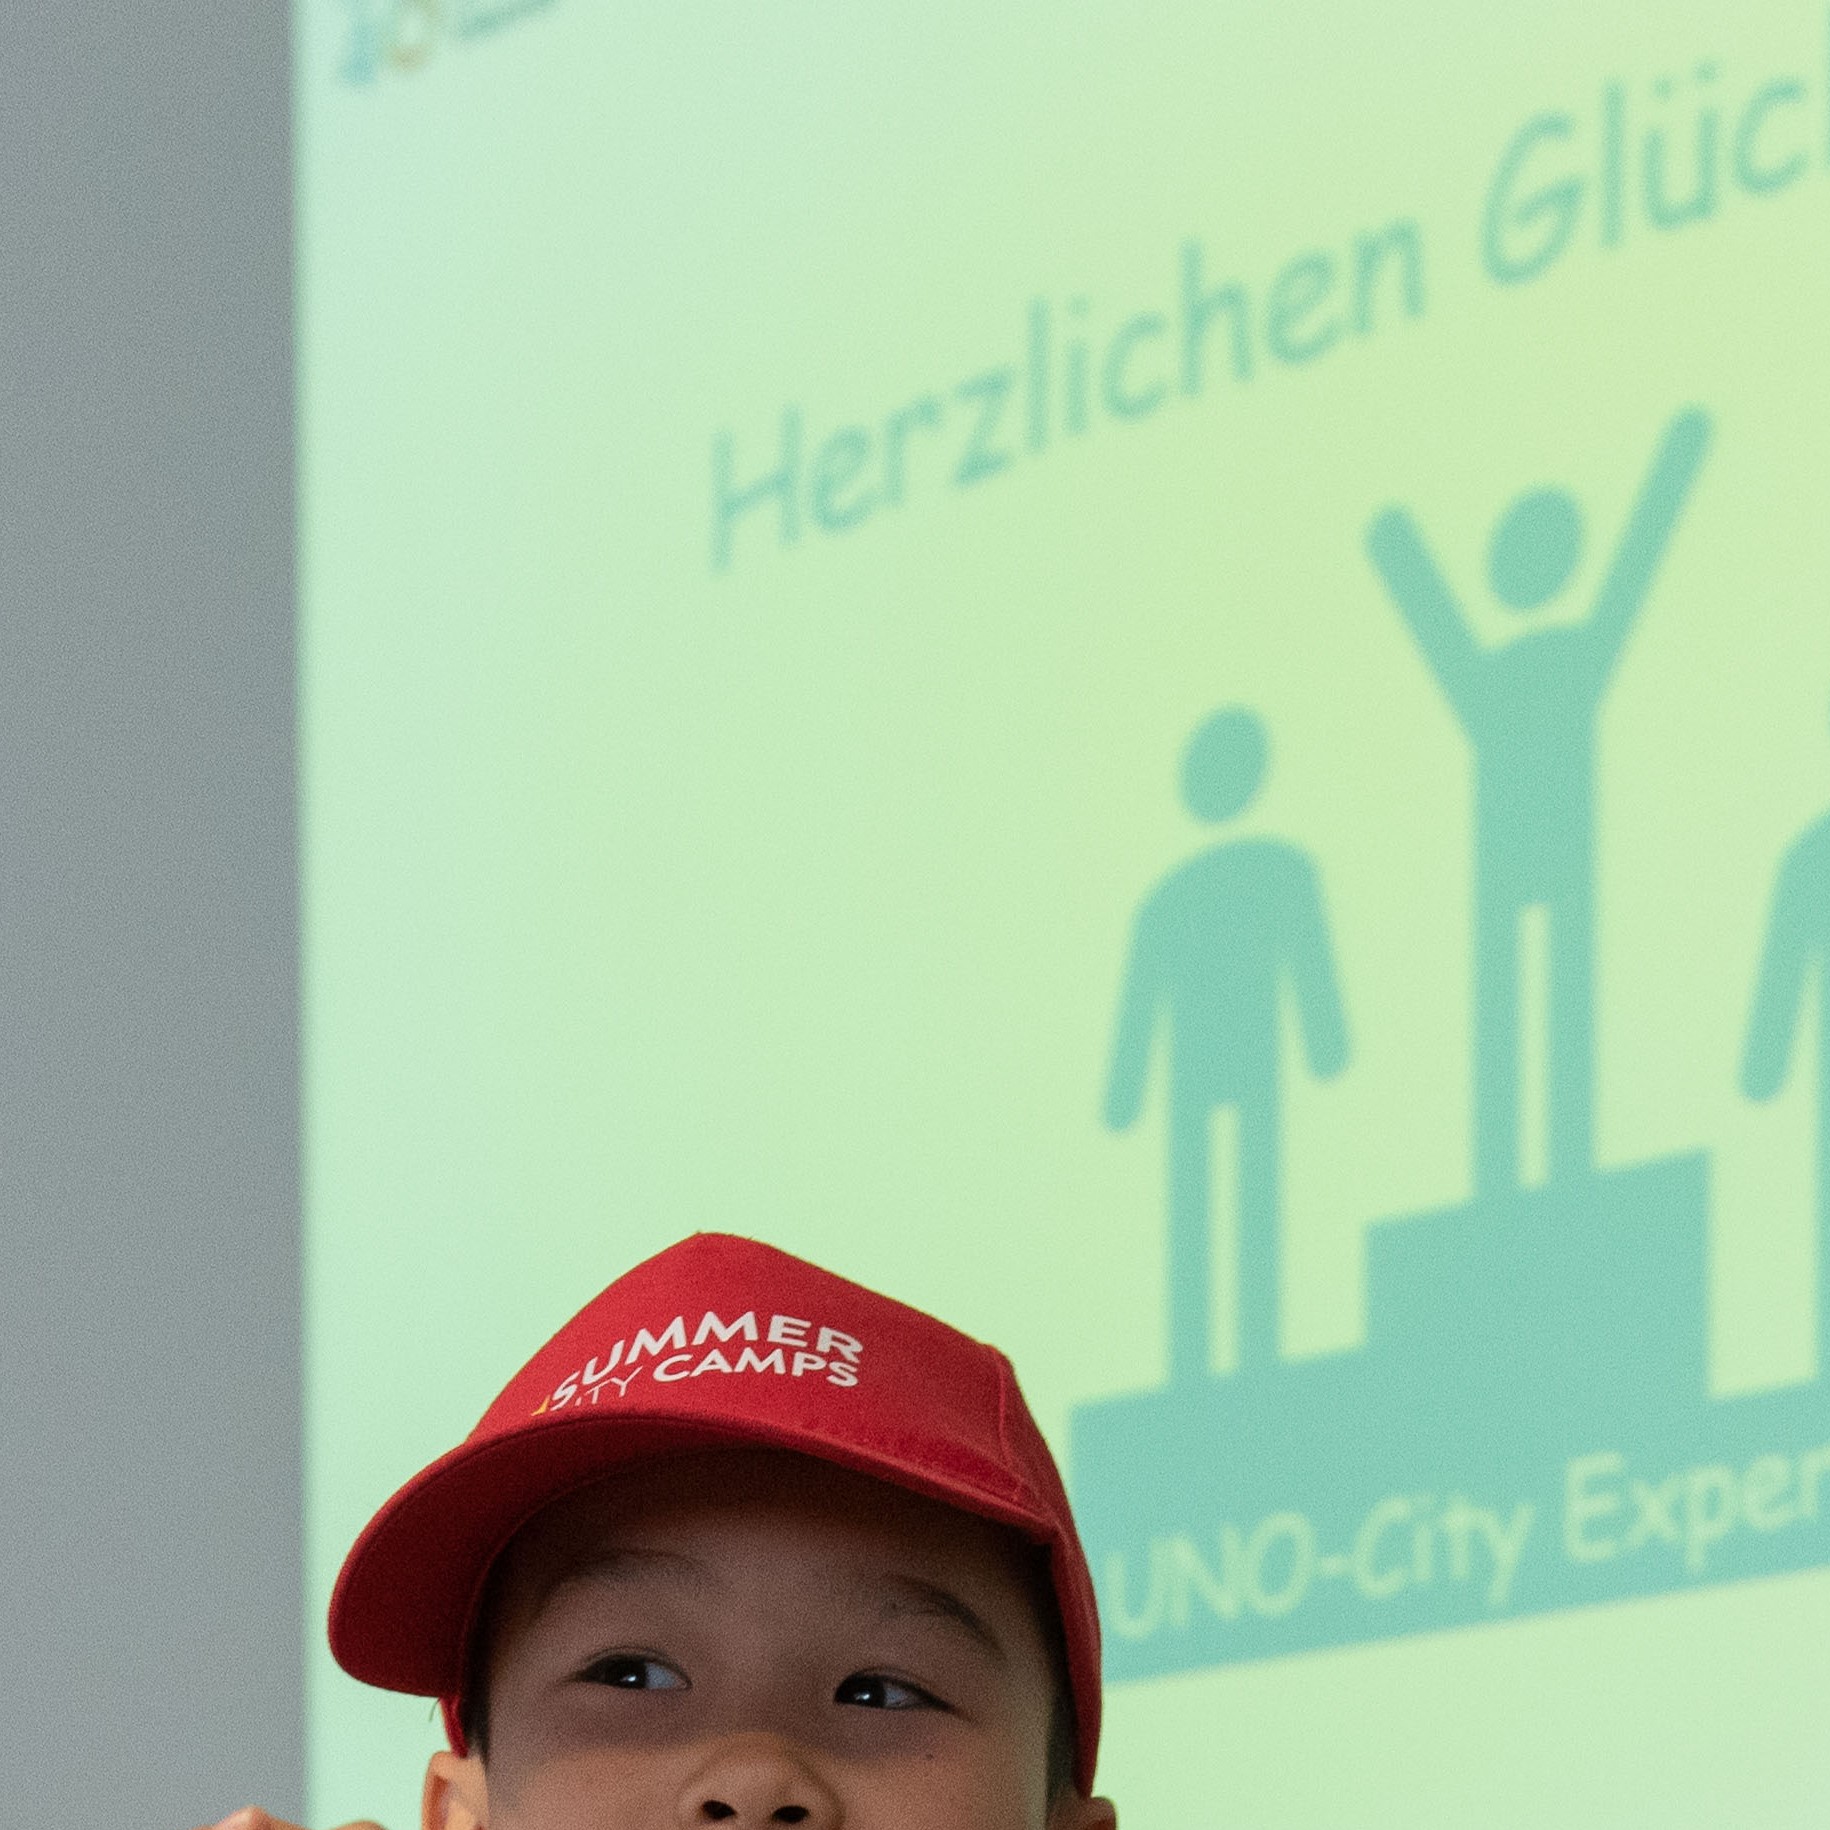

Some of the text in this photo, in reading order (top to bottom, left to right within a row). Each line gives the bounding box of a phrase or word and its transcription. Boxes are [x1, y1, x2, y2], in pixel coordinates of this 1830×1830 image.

[710, 217, 1427, 573] Herzlichen
[550, 1311, 864, 1411] SUMMER
[653, 1347, 859, 1388] CAMPS
[1104, 1493, 1535, 1640] UNO-City
